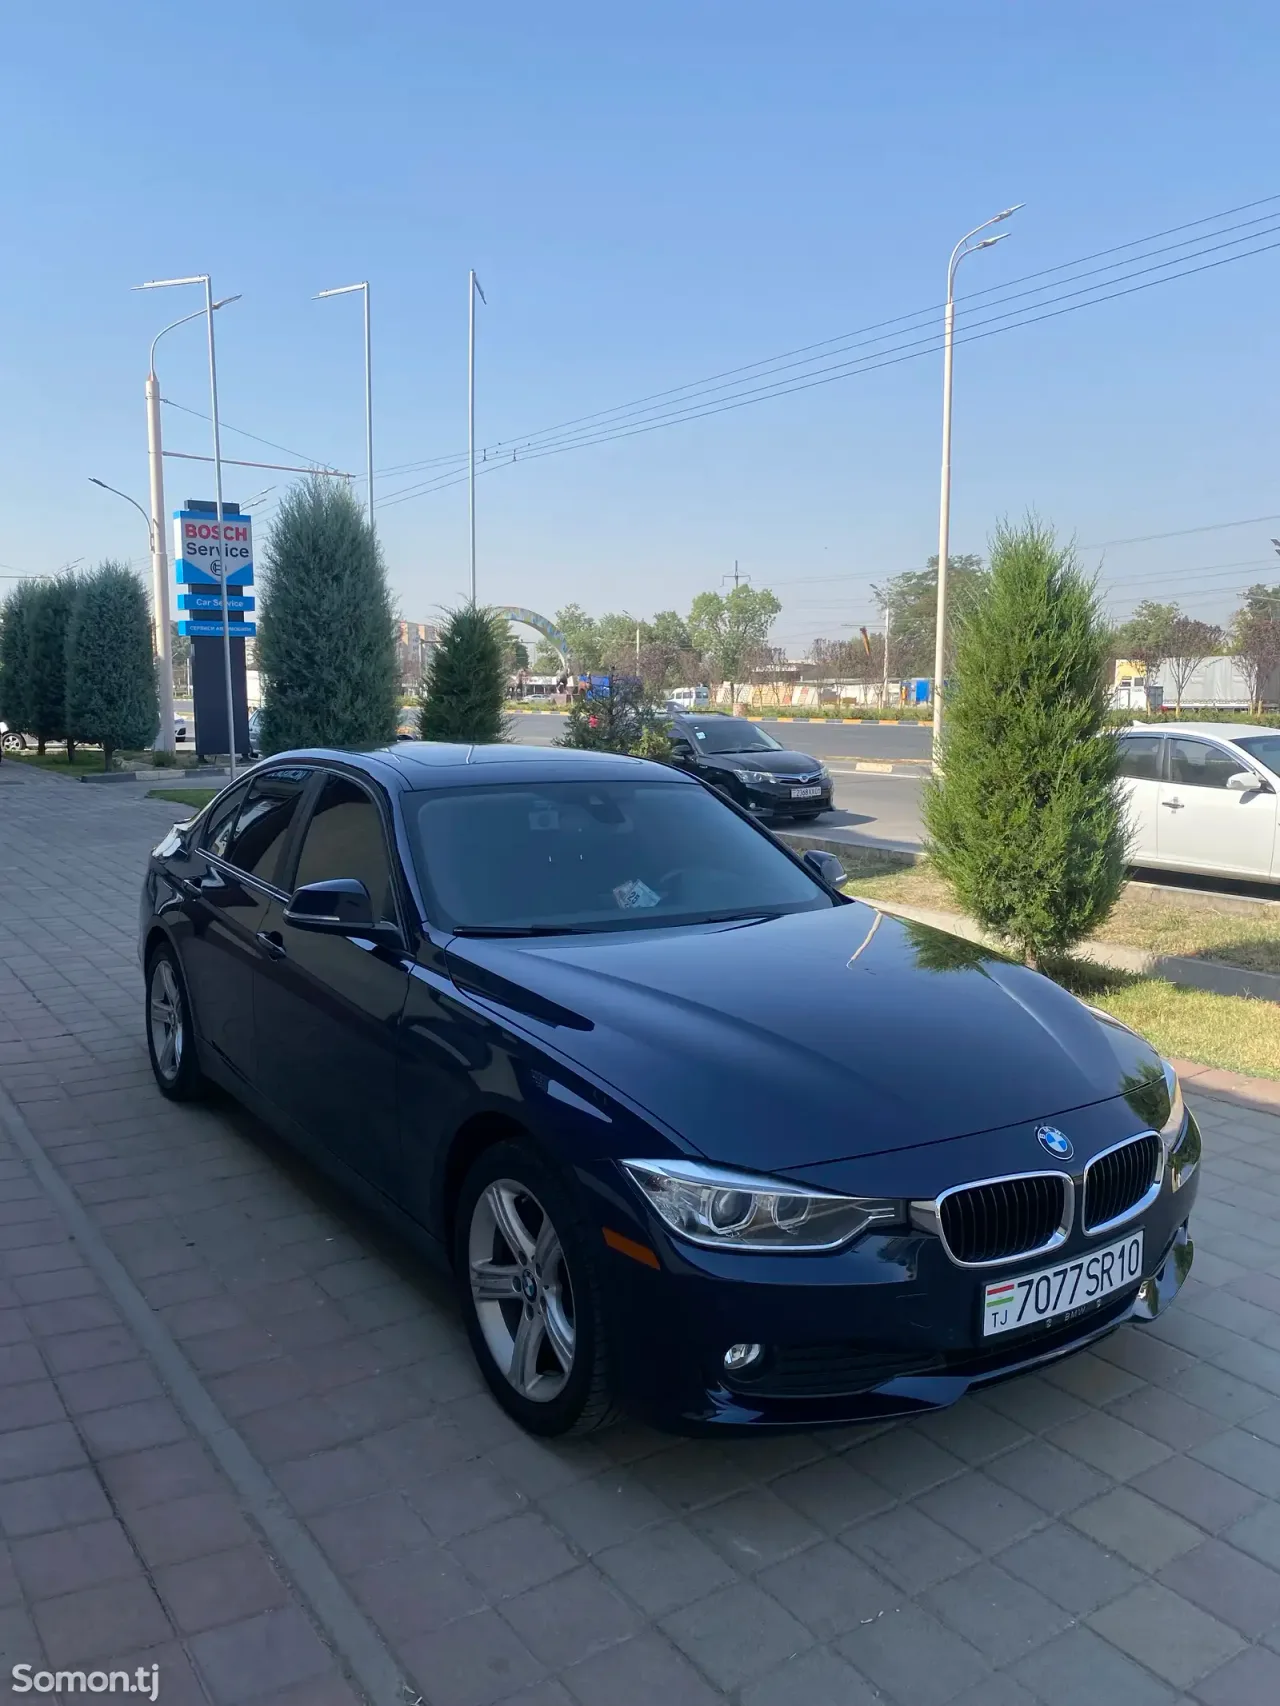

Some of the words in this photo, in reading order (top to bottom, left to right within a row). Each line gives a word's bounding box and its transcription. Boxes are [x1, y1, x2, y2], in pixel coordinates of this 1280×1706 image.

[184, 523, 248, 541] BOSCH
[196, 598, 212, 607] Car
[213, 598, 244, 607] Sevice
[991, 1309, 1008, 1328] TJ
[1016, 1238, 1140, 1322] 7077SR10
